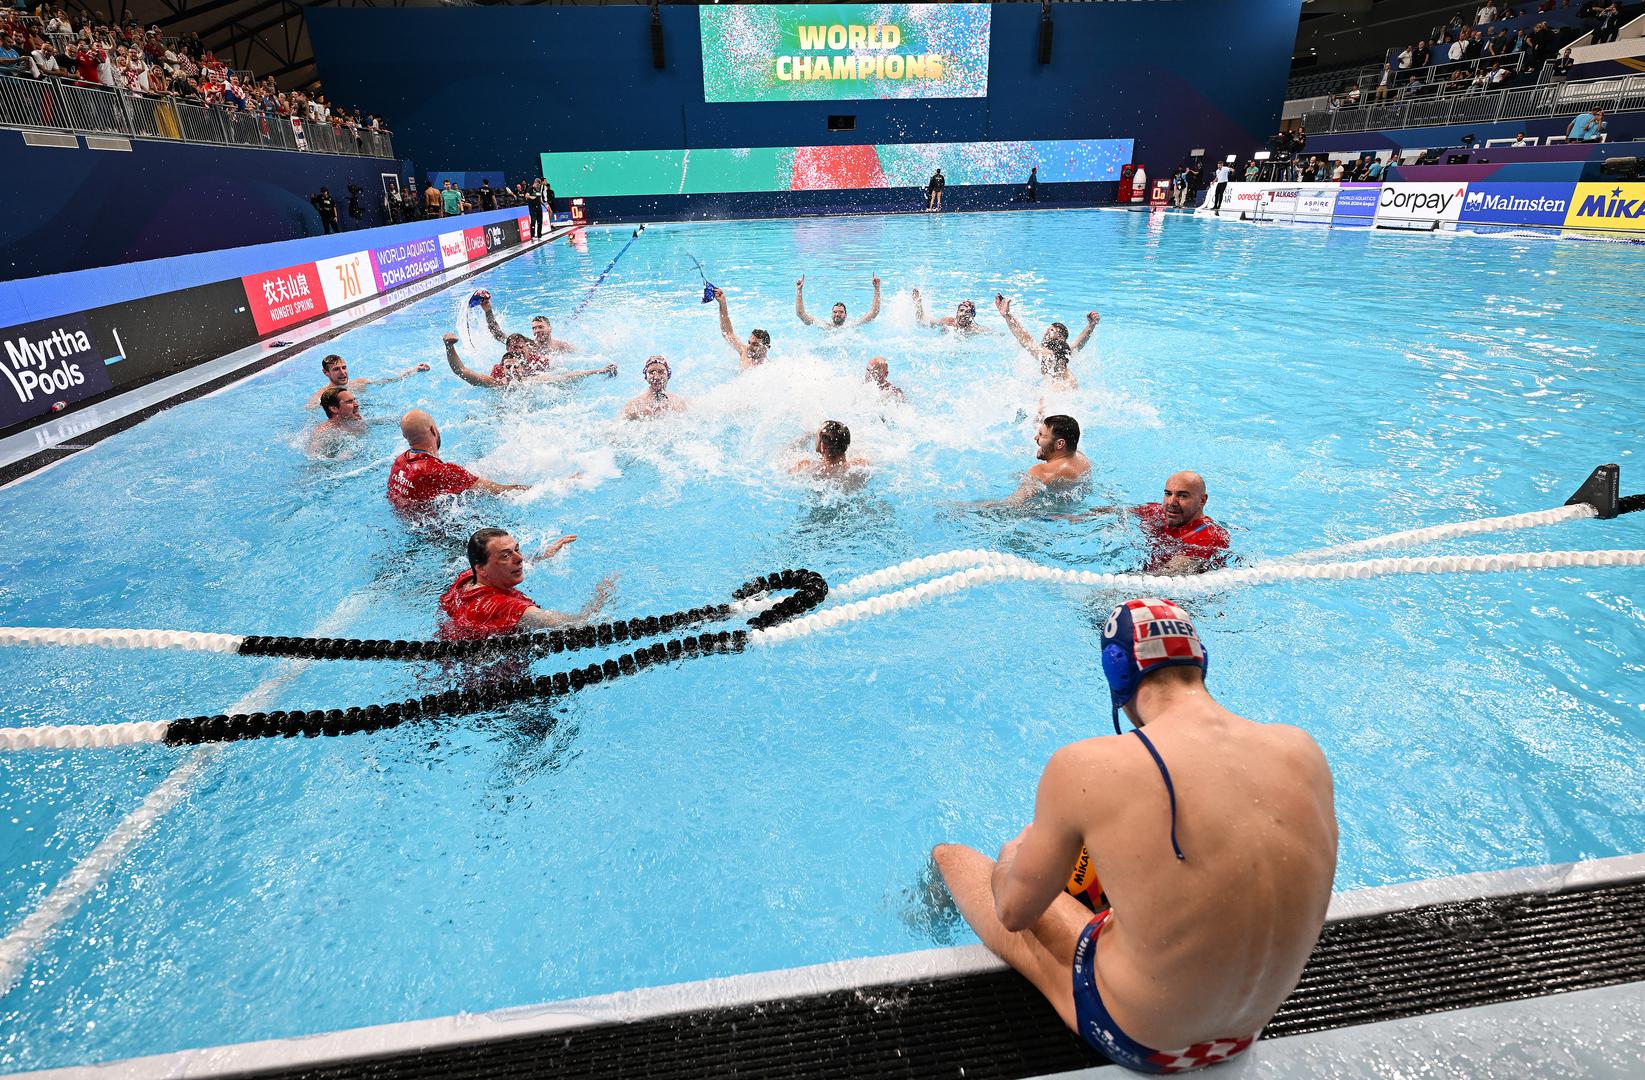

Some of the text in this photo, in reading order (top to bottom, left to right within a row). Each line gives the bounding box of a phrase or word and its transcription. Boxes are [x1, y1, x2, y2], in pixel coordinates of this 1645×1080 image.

[798, 25, 901, 50] WORLD
[776, 55, 944, 81] CHAMPIONS
[1238, 192, 1263, 200] ooredoo
[1381, 187, 1454, 214] Corpay
[1483, 194, 1565, 212] Malmsten
[377, 240, 435, 265] WORLD AQUATICS
[382, 261, 424, 286] DOHA 2024
[263, 272, 310, 305] 农夫山泉
[270, 298, 314, 321] NONGFU SPRING
[4, 328, 91, 371] Myrtha
[19, 360, 85, 402] Pools
[1104, 606, 1122, 639] 8
